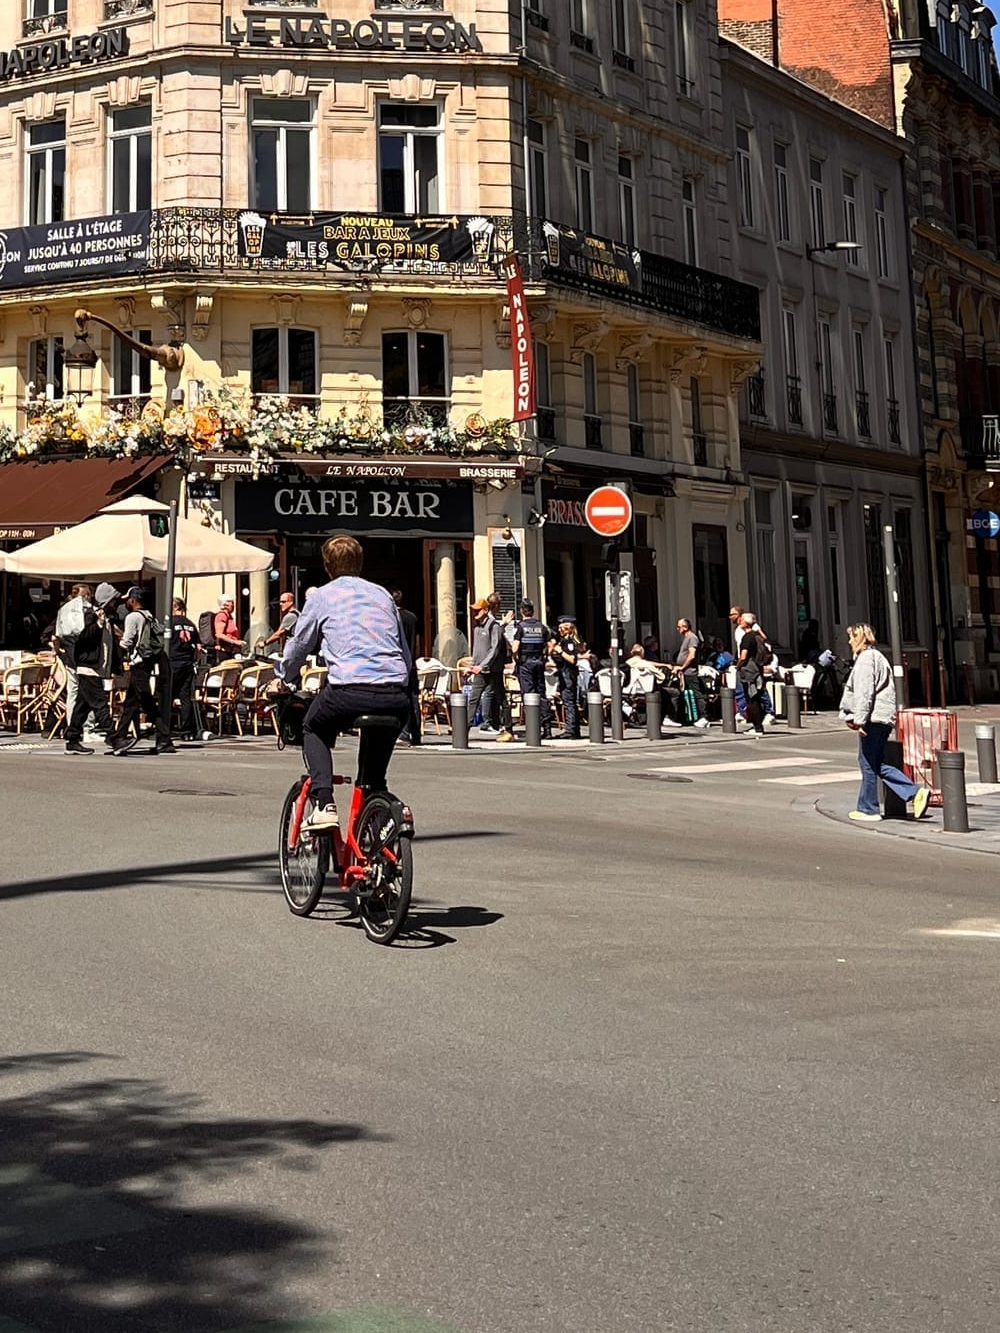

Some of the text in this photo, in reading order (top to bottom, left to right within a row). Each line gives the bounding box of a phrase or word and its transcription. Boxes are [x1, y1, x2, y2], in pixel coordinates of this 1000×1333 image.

[225, 15, 483, 52] LE NAPOLEON
[47, 219, 123, 241] SALLE À L'ÉTAGE
[341, 217, 393, 227] NOUVEAU
[323, 226, 411, 241] BAR A JEUX
[27, 234, 143, 260] JUSQU'À 40 PERSONNES
[295, 241, 440, 261] LES GALOPINS
[23, 264, 47, 274] SERVICE
[47, 260, 74, 271] CONTINU
[74, 259, 79, 268] 7
[79, 257, 105, 268] JOURS/7
[104, 255, 114, 264] DE
[506, 264, 517, 280] LE
[512, 293, 530, 412] NAPOLEON
[214, 463, 281, 474] RESTAUANT
[326, 466, 342, 475] LE
[459, 468, 517, 479] BRASSERIE
[274, 488, 440, 518] CAFE BAR
